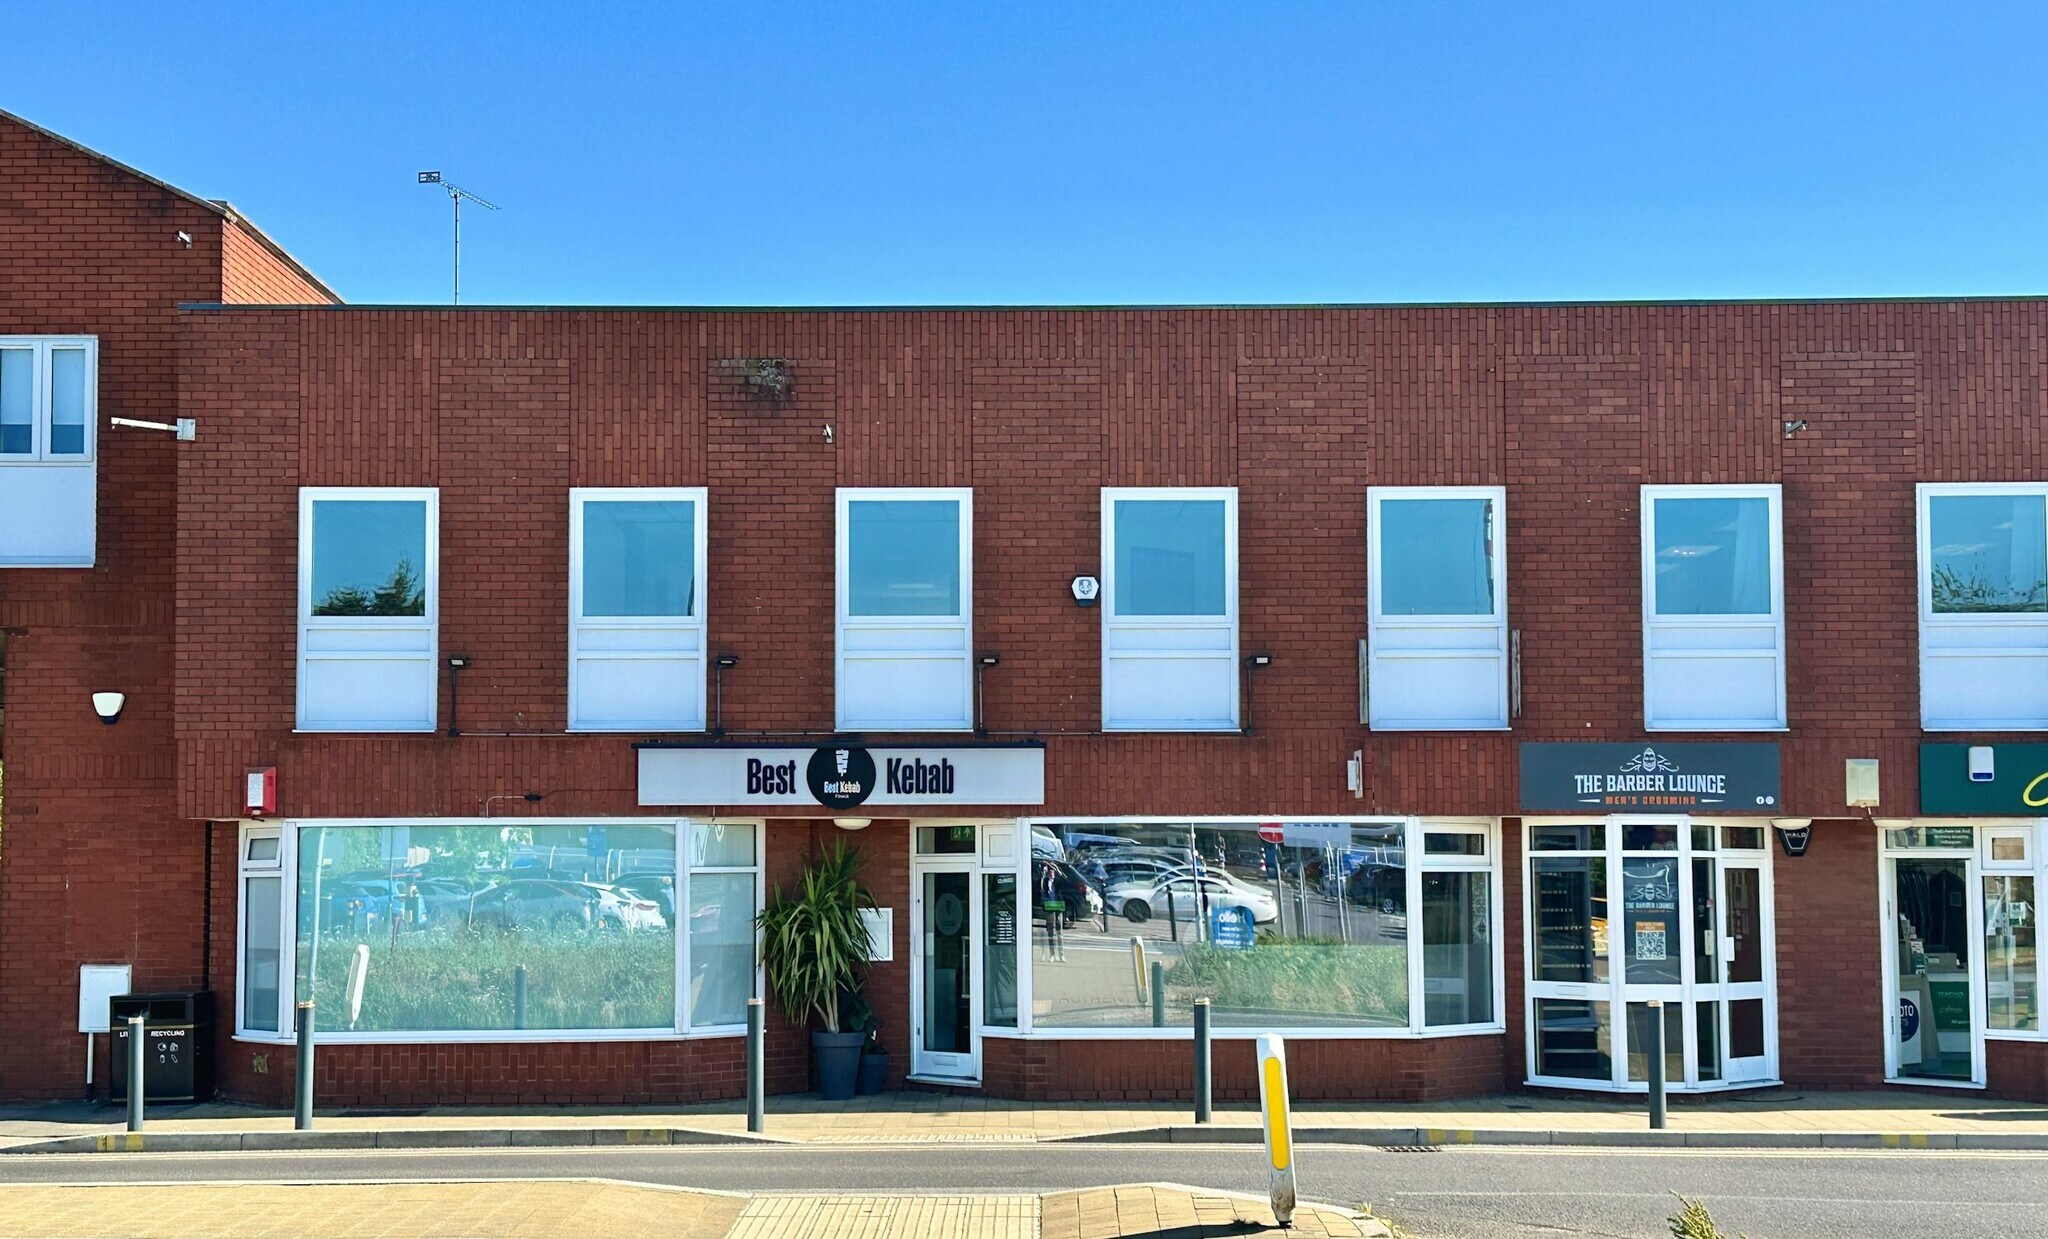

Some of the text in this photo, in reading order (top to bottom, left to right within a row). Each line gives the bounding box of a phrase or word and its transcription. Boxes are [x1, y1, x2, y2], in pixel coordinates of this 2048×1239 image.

[747, 758, 954, 794] Best Kebab
[824, 781, 861, 793] Best Kebab
[1575, 775, 1726, 794] THE BARBER LOUNGE
[1605, 796, 1696, 805] MEN'S GROOMING
